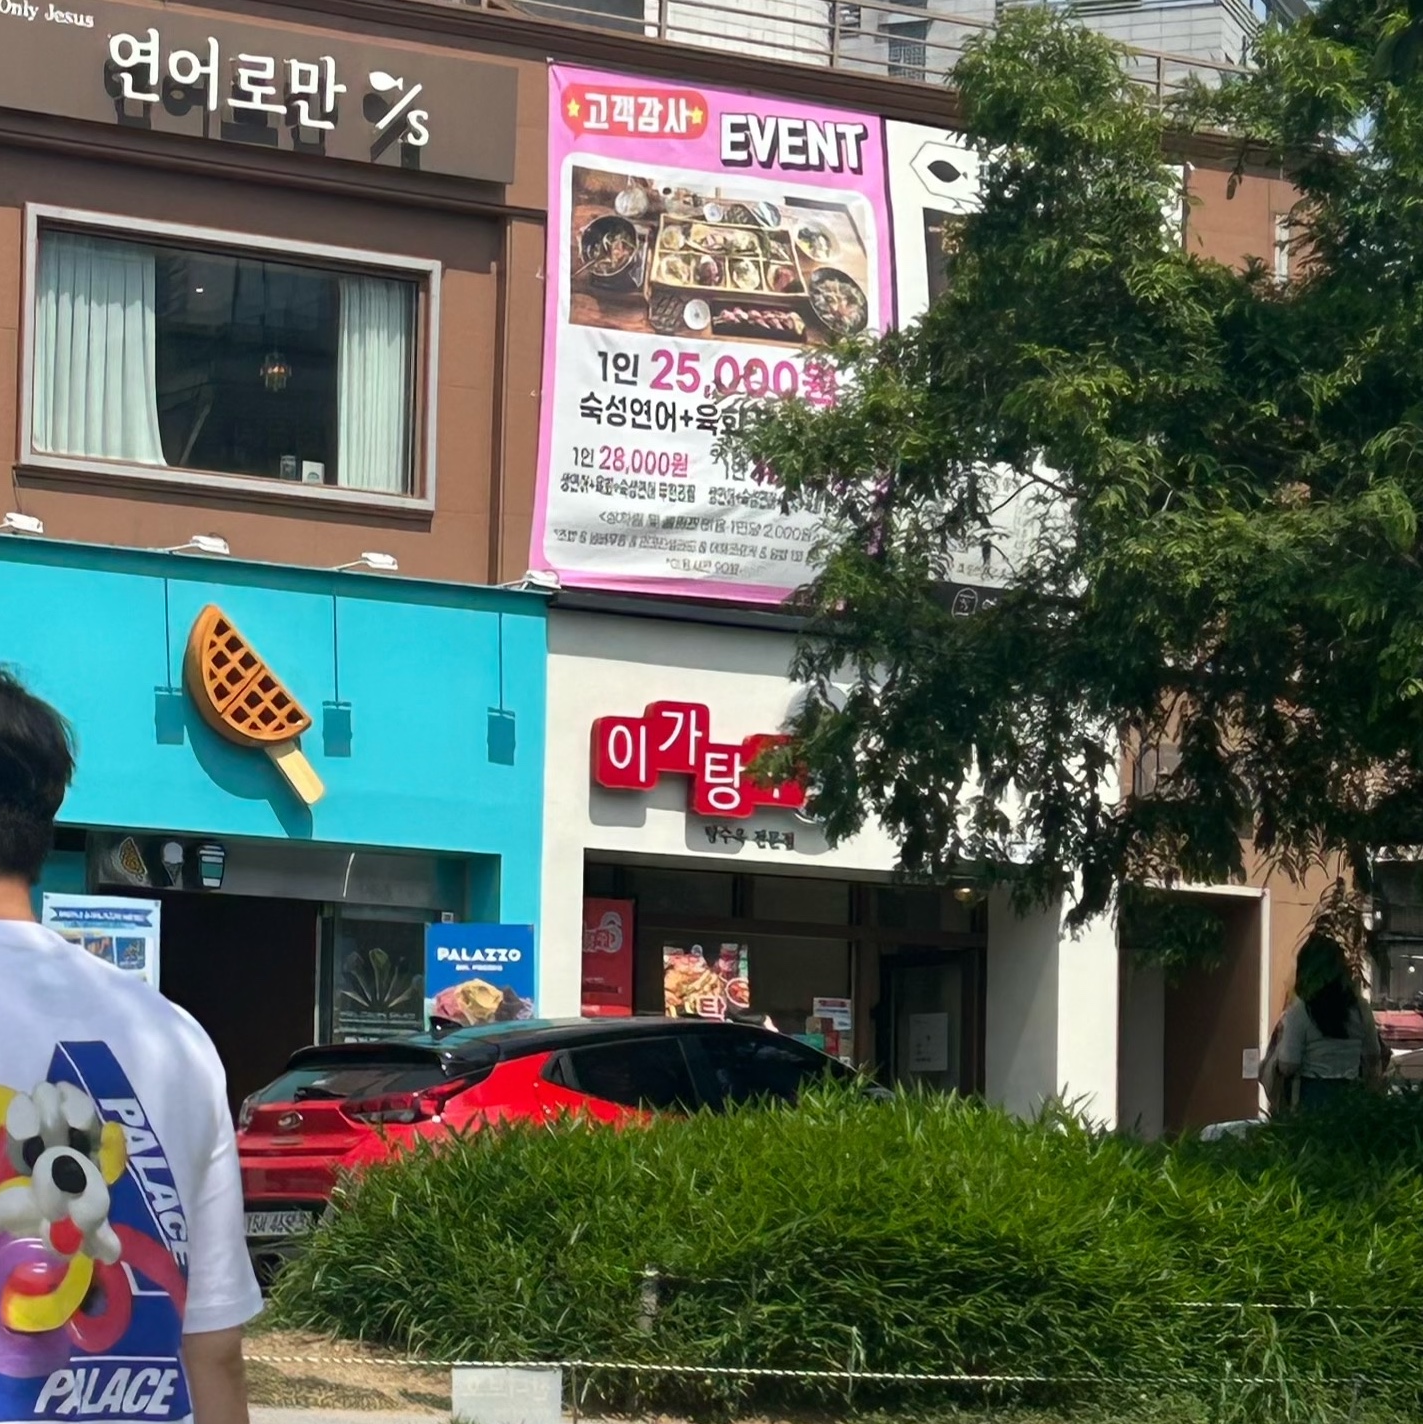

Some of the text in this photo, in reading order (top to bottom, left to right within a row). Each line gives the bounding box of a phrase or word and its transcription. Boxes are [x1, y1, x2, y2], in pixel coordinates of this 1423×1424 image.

[44, 7, 95, 28] Jesus
[108, 27, 347, 131] 연어로만
[582, 92, 691, 134] 고객감사
[719, 112, 867, 174] EVENT
[597, 349, 640, 387] 1인
[572, 444, 689, 479] 1인 28,000원
[607, 708, 782, 811] 이가탕
[436, 946, 522, 963] PALAZZO
[97, 1098, 189, 1269] PALACE
[32, 1367, 179, 1416] PALACE
